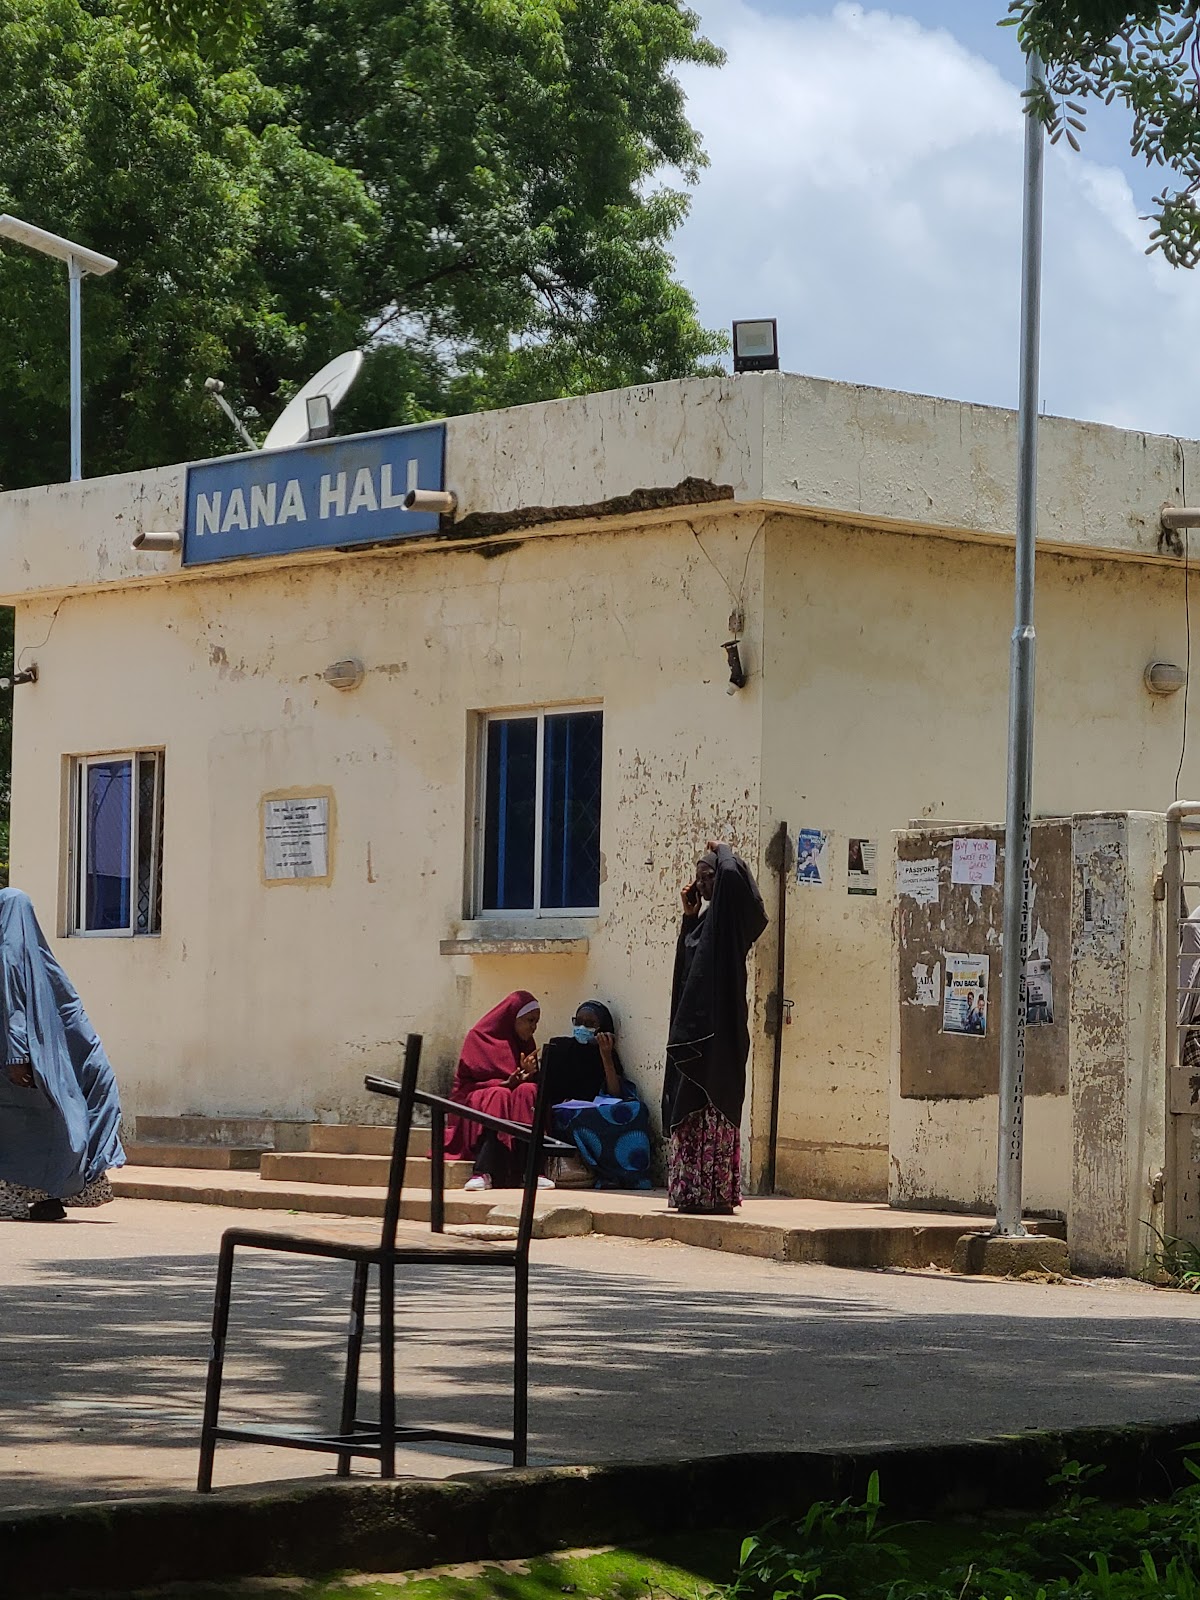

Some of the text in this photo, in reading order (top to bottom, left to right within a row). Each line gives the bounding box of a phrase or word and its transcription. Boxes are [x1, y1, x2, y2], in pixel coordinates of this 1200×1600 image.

[196, 479, 307, 536] NANA
[954, 840, 989, 854] BUY YOUR
